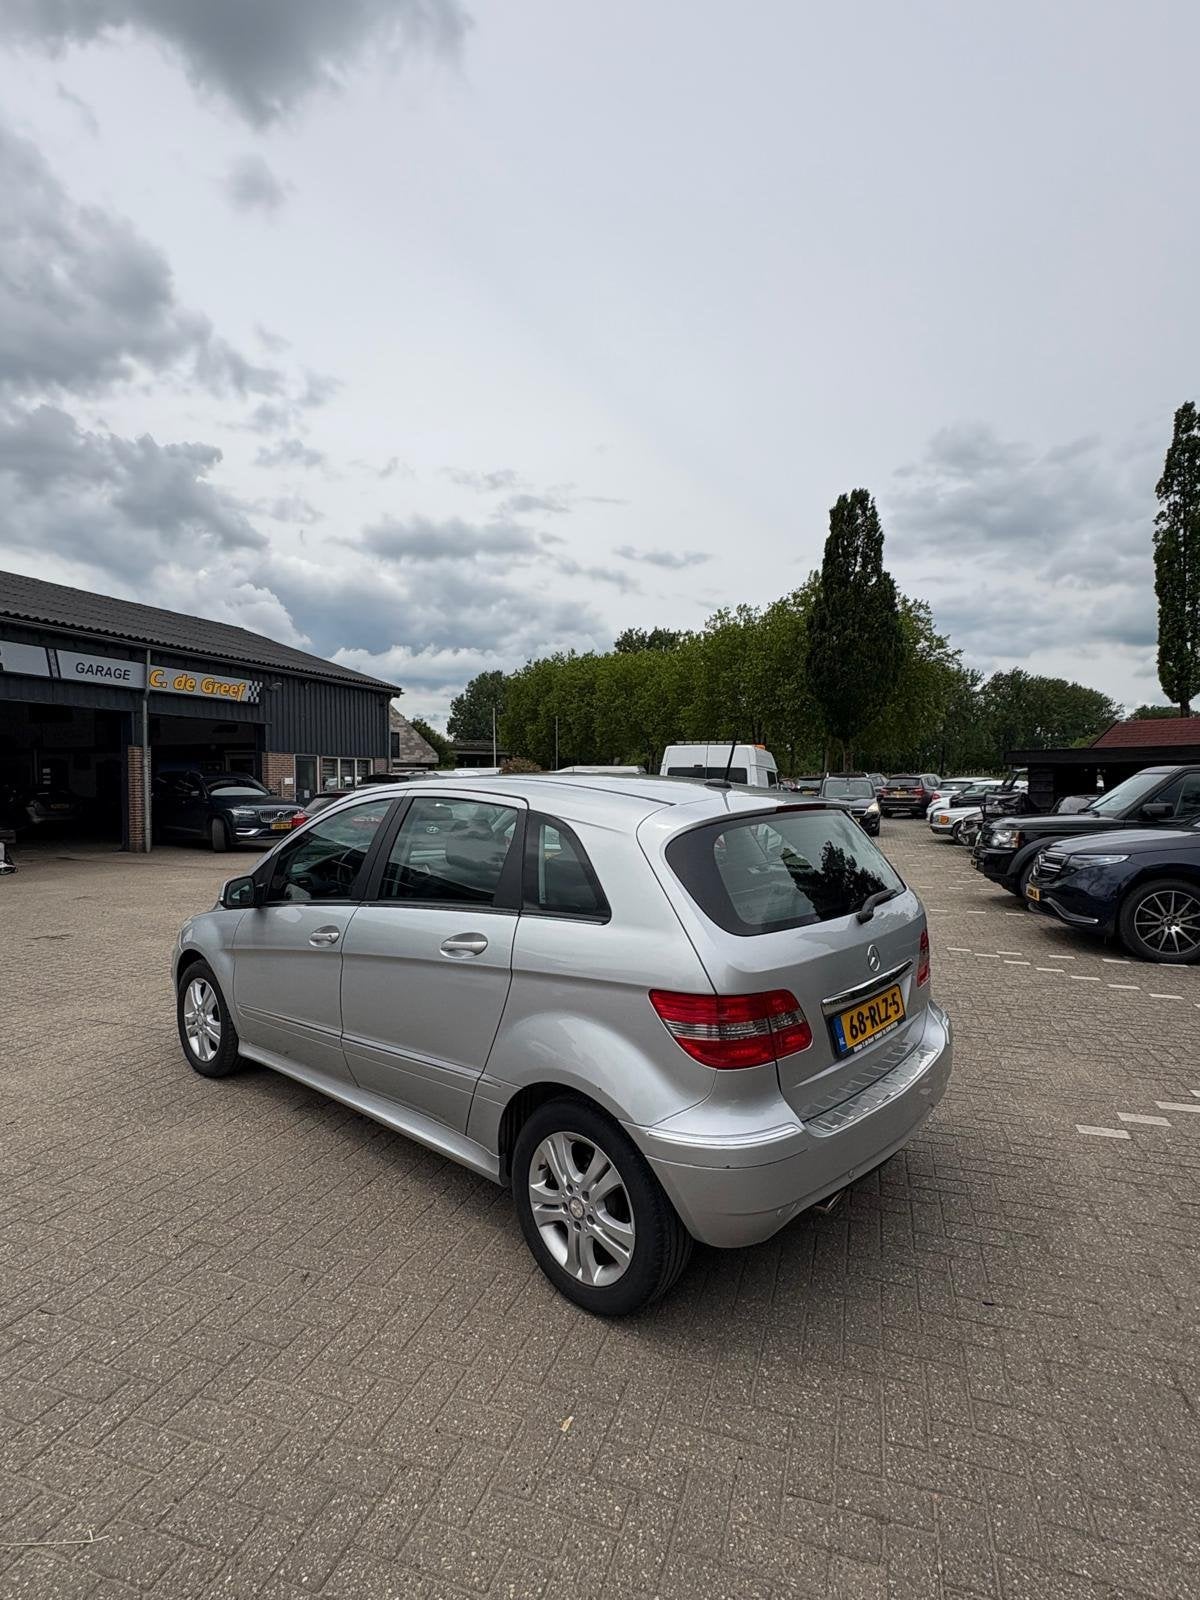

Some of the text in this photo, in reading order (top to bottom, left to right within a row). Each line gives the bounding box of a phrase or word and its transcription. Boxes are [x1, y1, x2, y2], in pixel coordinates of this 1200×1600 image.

[75, 662, 131, 681] GARAGE
[149, 669, 246, 702] C. de Greef
[849, 992, 900, 1040] 68-RLZ-5
